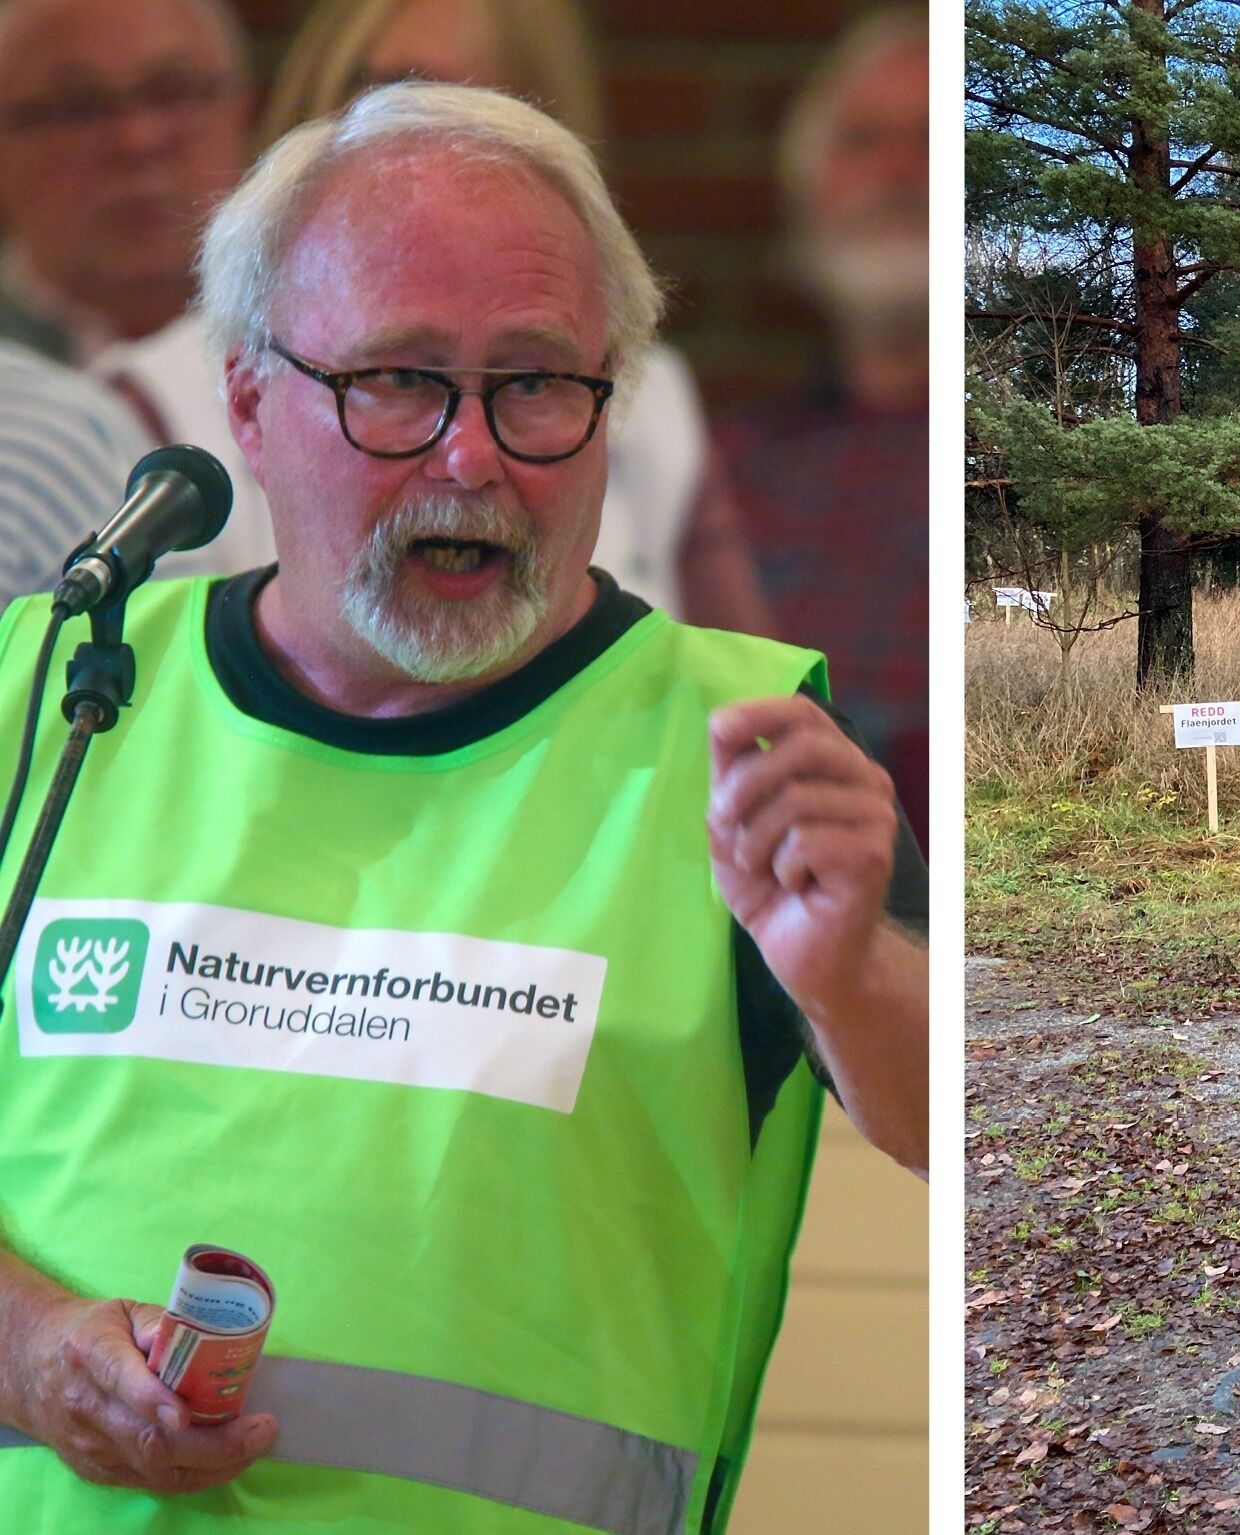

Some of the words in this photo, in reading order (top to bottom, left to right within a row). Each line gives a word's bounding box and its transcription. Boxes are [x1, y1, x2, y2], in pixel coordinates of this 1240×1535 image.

[1181, 718, 1237, 728] Flaenjordet
[1191, 706, 1225, 717] REDD
[165, 941, 579, 1024] Naturvernforbundet
[158, 984, 169, 1017] i
[179, 988, 412, 1042] Groruddalen
